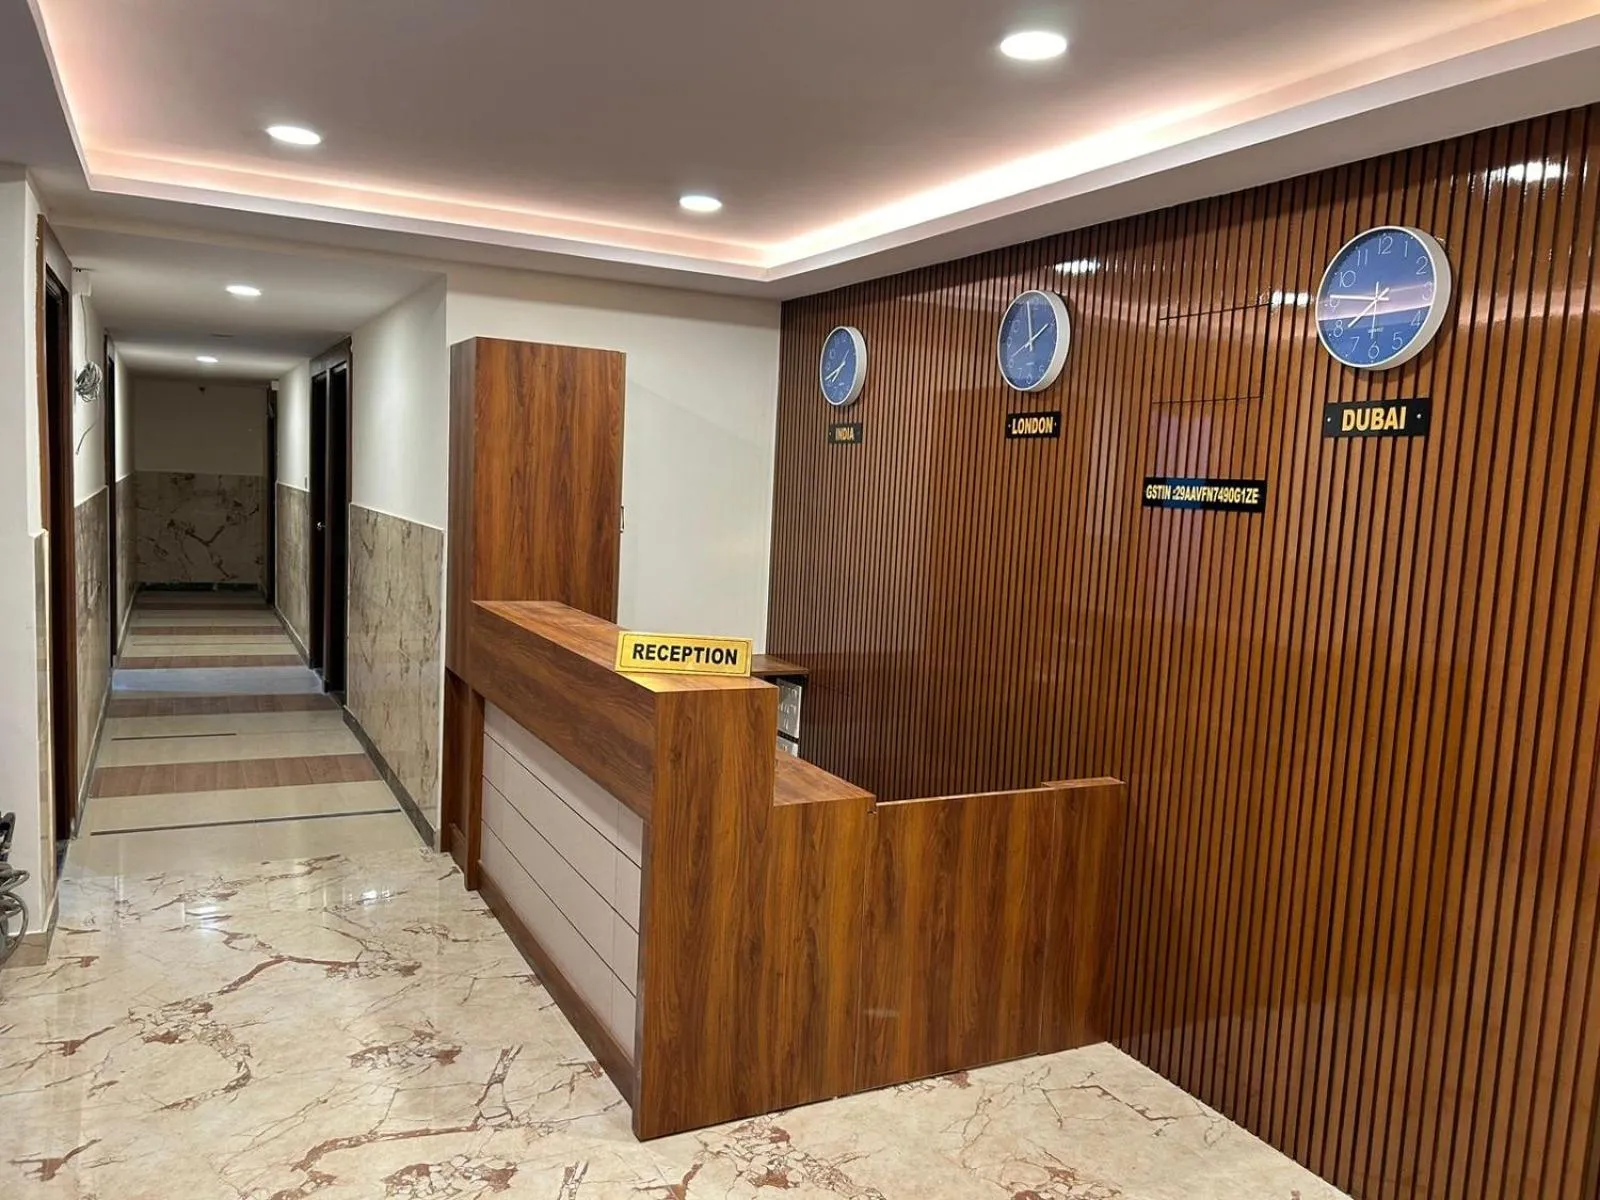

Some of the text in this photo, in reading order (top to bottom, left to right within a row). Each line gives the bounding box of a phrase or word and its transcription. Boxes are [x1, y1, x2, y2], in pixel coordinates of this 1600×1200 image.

[1377, 236, 1393, 255] 12
[1403, 240, 1408, 258] 1
[1357, 248, 1369, 267] 11
[1415, 255, 1429, 276] 2
[1339, 270, 1356, 288] 10
[1422, 281, 1433, 301] 3
[1333, 319, 1344, 338] 8
[1410, 311, 1421, 328] 4
[1350, 336, 1360, 353] 7
[1368, 341, 1380, 360] 6
[1391, 332, 1403, 351] 5
[1011, 416, 1054, 435] LONDON
[1341, 406, 1407, 431] DUBAI
[835, 427, 855, 441] INDIA
[1146, 484, 1171, 500] GSTIN
[632, 643, 738, 665] RECEPTION
